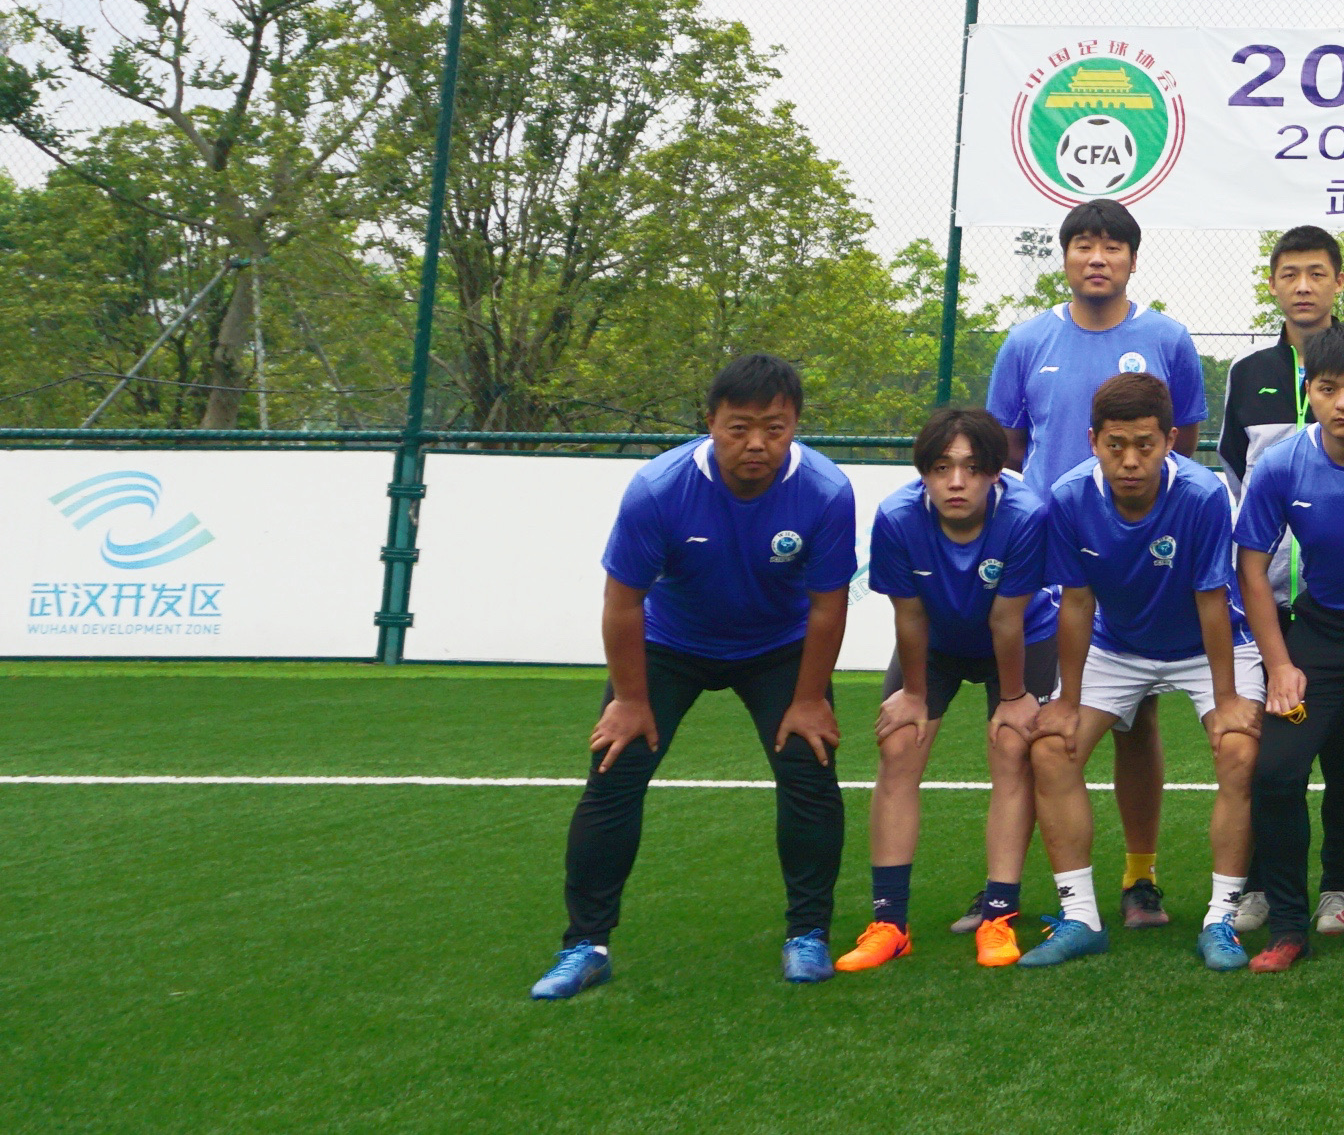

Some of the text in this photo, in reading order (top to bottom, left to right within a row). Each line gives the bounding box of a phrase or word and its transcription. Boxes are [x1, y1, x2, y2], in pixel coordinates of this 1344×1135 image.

[1073, 145, 1121, 165] CFA
[29, 583, 225, 617] 武汉开发区
[28, 624, 222, 635] WUHAN DEVELOPMENT ZONE
